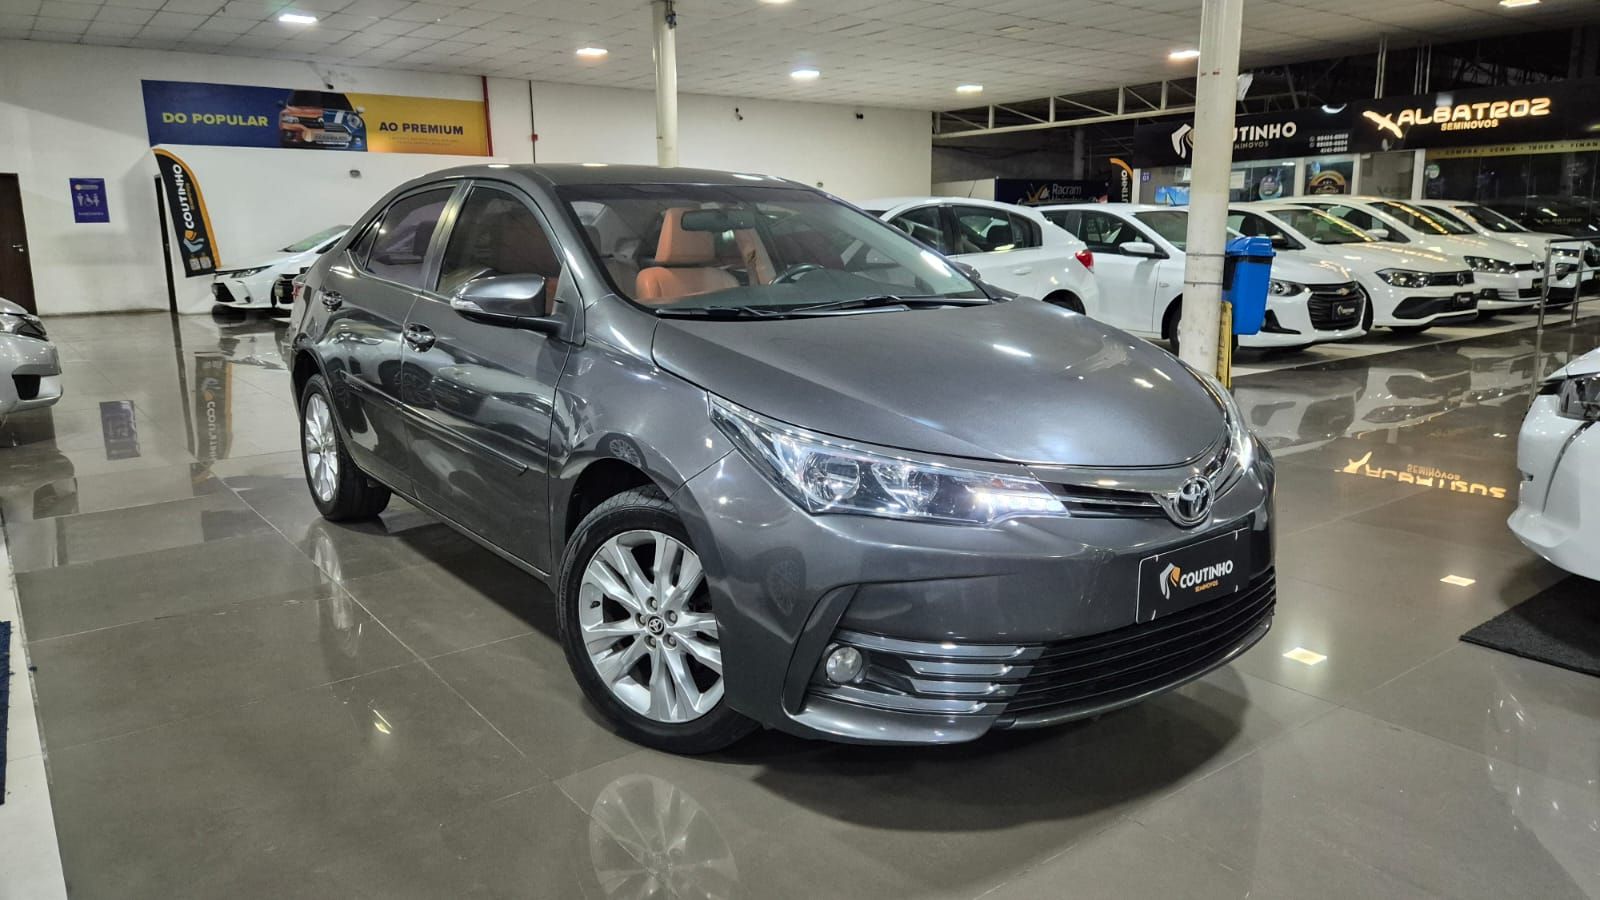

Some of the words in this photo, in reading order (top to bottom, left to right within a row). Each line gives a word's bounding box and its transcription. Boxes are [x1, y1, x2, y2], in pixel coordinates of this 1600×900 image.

[1397, 97, 1551, 126] ALBATROZ
[162, 112, 187, 124] DO
[192, 113, 269, 127] POPULAR
[1440, 118, 1499, 132] SEMINOVOS
[379, 121, 399, 132] AO
[402, 123, 464, 135] PREMIUM
[172, 164, 195, 230] COUTINHO
[1052, 183, 1082, 196] Racram
[1180, 560, 1234, 589] COUTINHO
